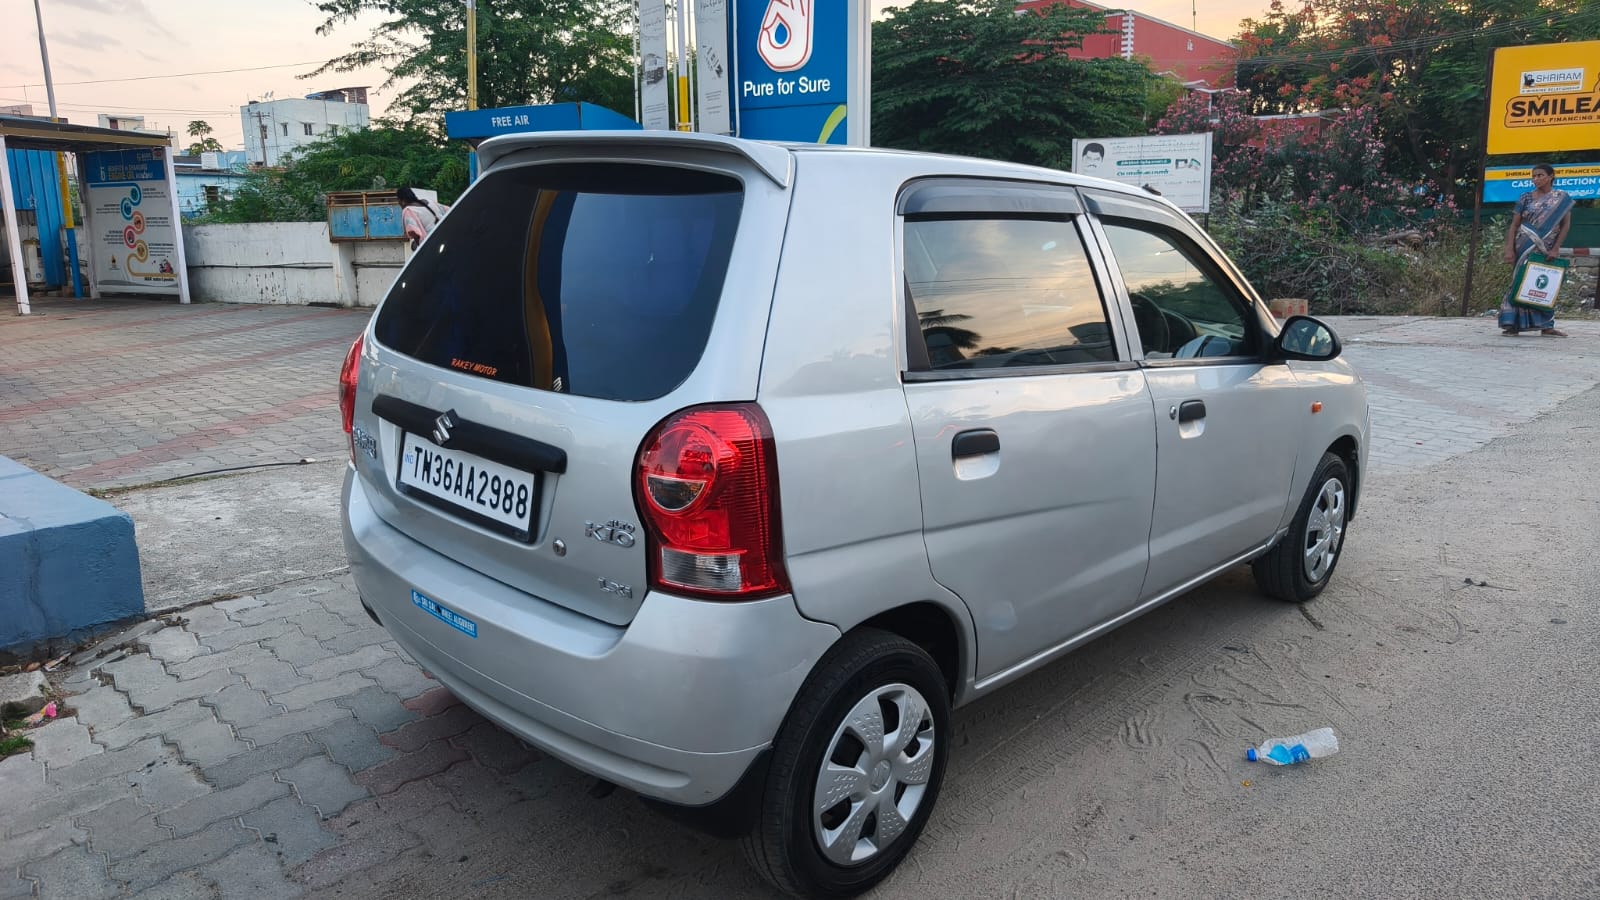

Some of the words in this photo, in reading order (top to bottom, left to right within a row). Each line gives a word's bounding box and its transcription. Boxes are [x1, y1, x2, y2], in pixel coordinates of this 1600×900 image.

[1536, 72, 1582, 82] SHRIRAM
[743, 81, 774, 97] Pure
[777, 78, 795, 95] for
[799, 76, 831, 93] Sure
[491, 116, 513, 128] FREE
[514, 114, 530, 126] AIR
[473, 363, 498, 376] MOTOR
[414, 445, 529, 519] TN36AA2988
